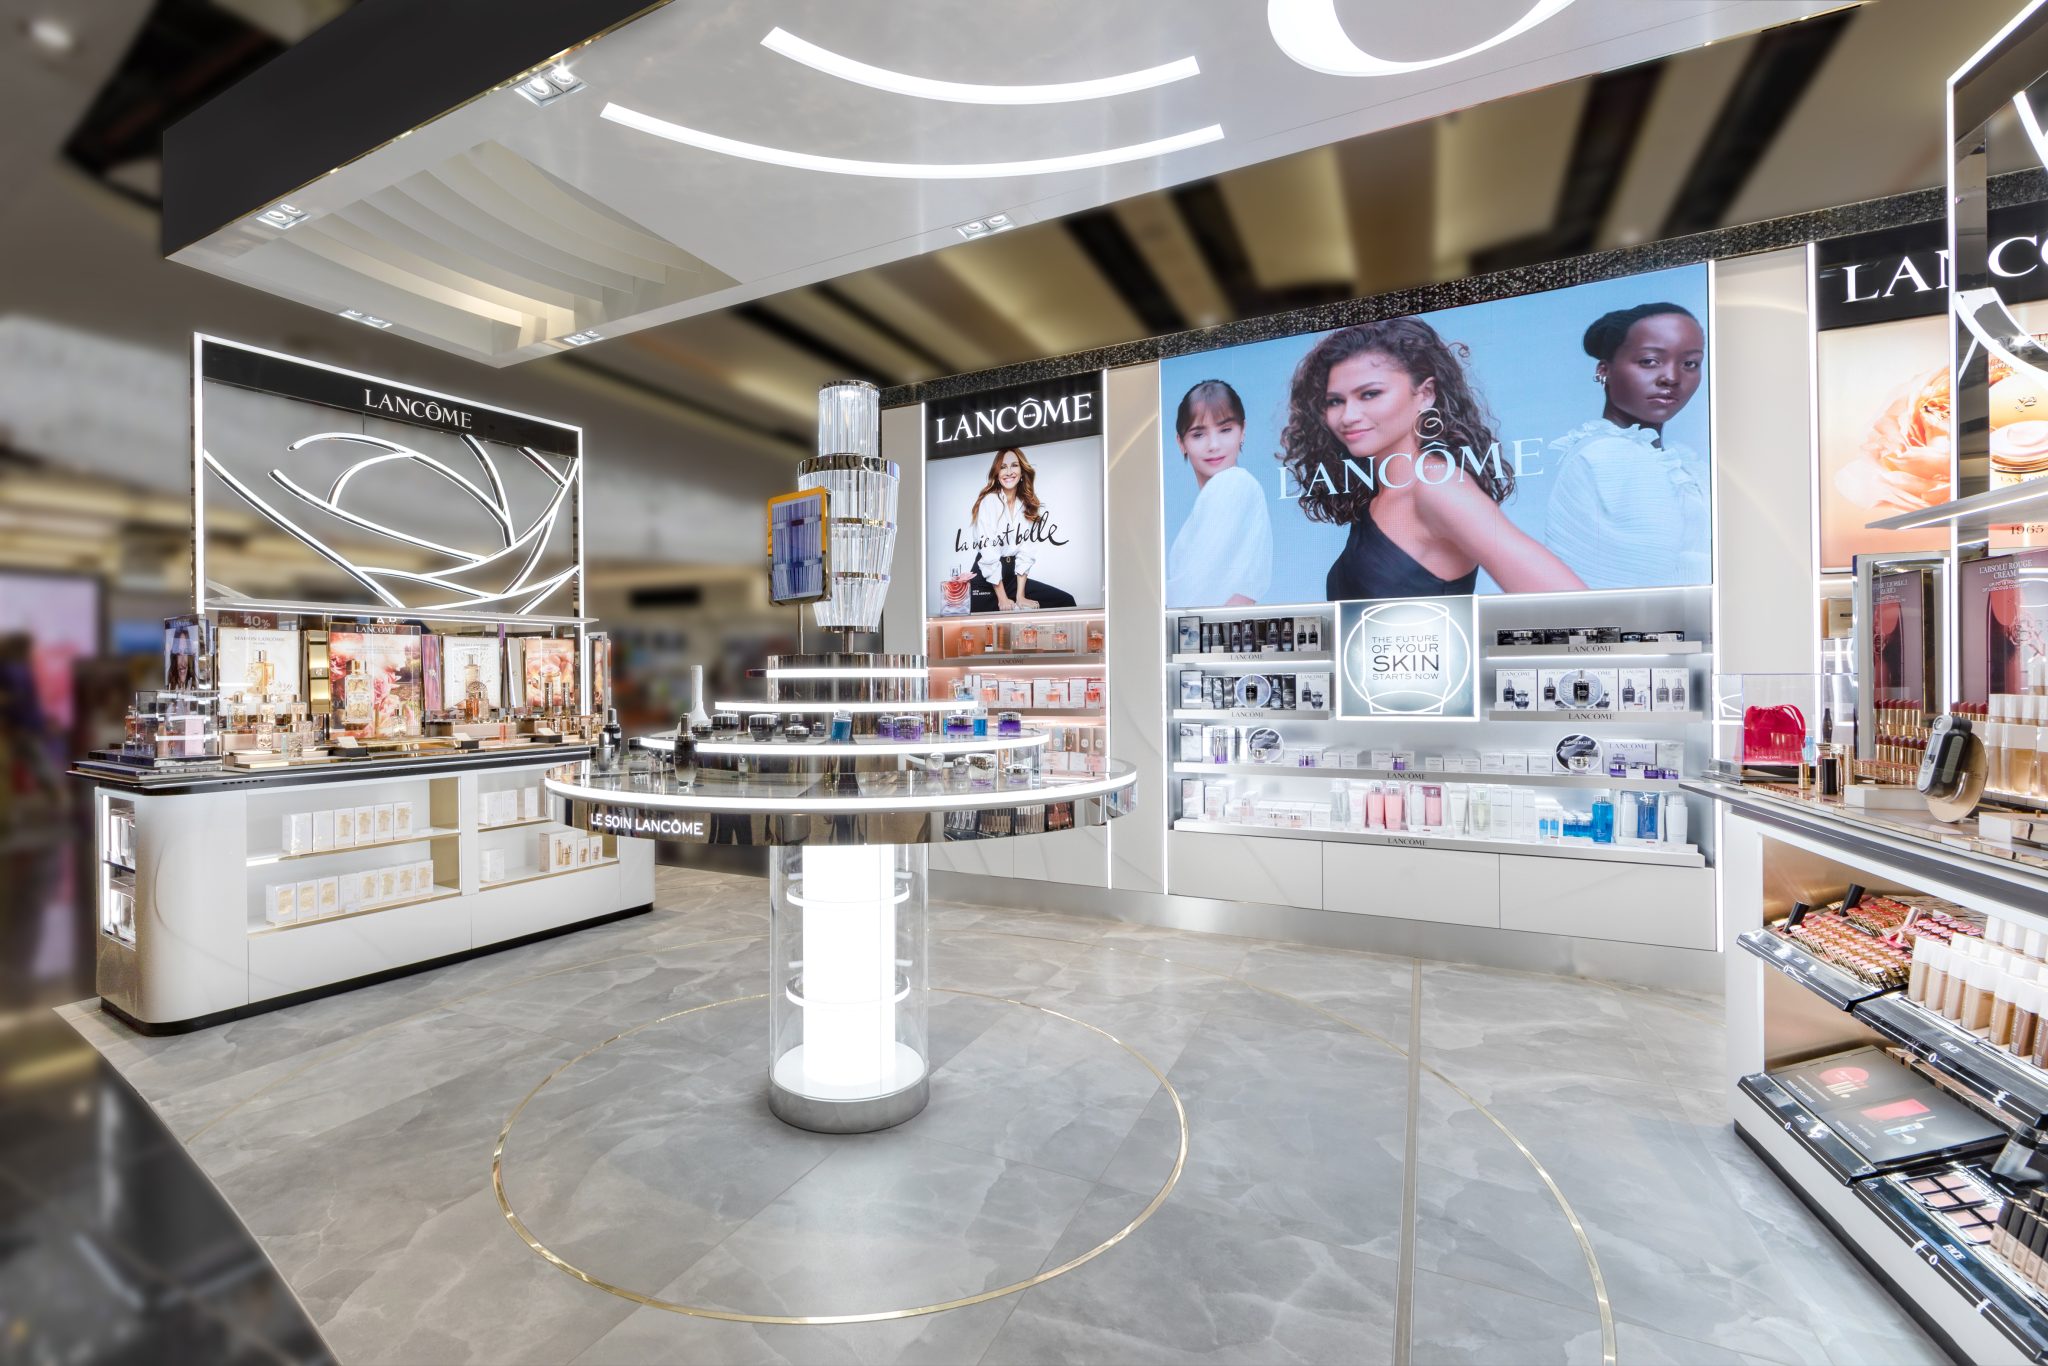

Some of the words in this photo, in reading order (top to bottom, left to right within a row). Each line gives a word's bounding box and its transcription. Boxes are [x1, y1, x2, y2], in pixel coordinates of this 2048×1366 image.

[364, 388, 472, 429] LANCÔME
[936, 393, 1092, 443] LANCÔME
[1277, 437, 1544, 500] LANCÔME
[955, 528, 969, 552] La
[972, 534, 989, 550] vie
[992, 523, 1015, 547] est
[1015, 510, 1070, 546] belle
[2008, 559, 2033, 570] ROUGE
[1993, 570, 2017, 580] CREAM
[1395, 634, 1439, 643] FUTURE
[1371, 644, 1391, 654] OF
[1395, 643, 1439, 653] YOUR
[1372, 654, 1440, 672] SKIN
[1372, 673, 1412, 681] STARTS
[590, 813, 603, 826] LE
[604, 814, 632, 829] SOIN
[635, 818, 704, 836] LANCÔME
